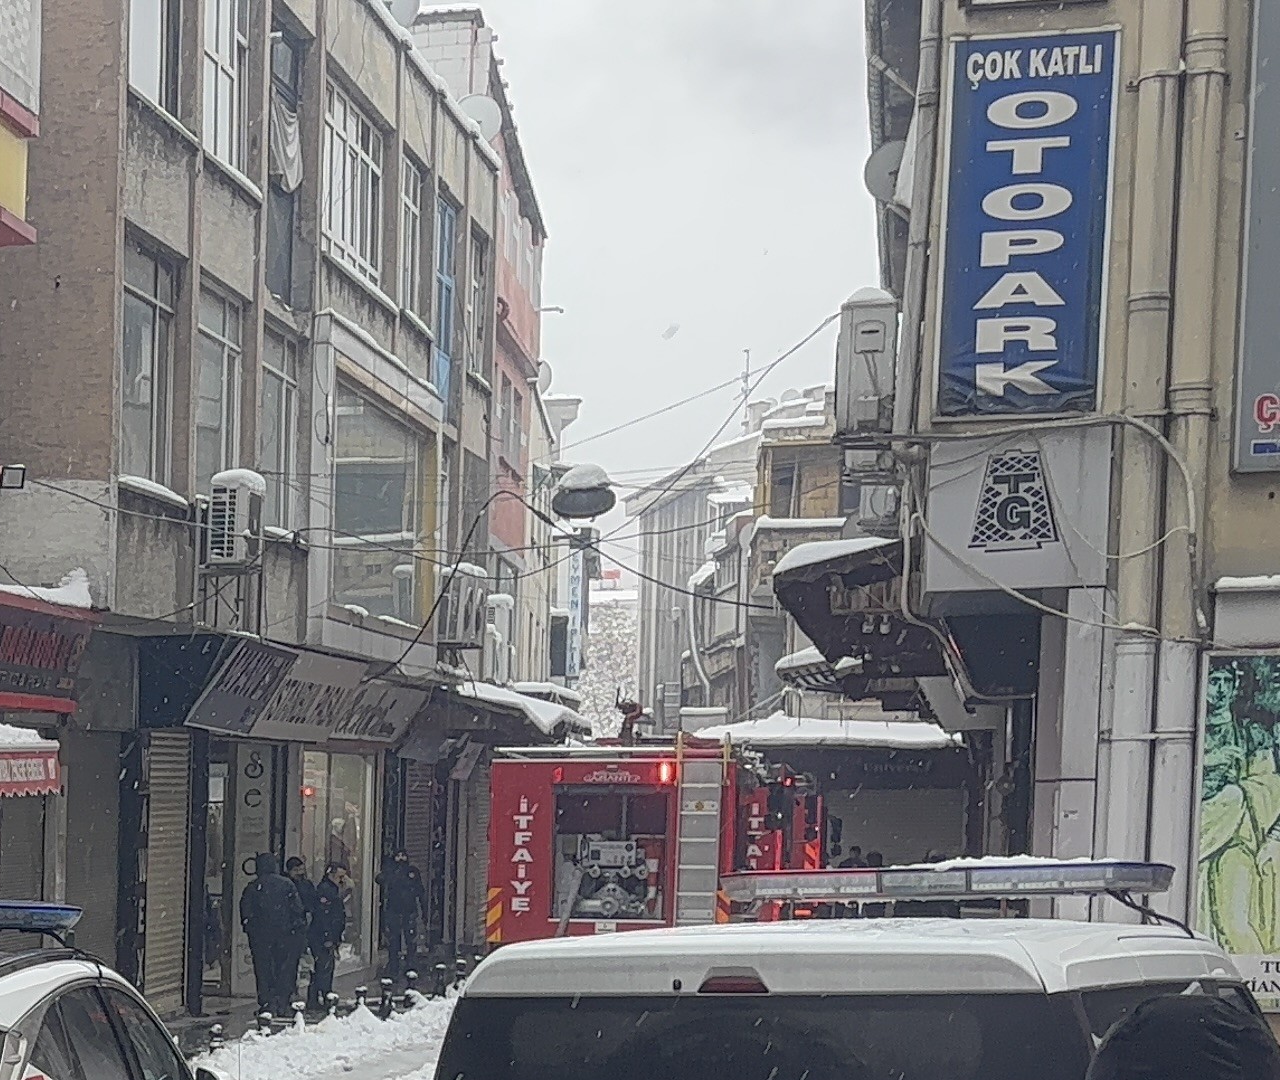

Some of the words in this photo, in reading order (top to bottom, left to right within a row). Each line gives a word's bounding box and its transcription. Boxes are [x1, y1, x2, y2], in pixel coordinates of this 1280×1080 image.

[966, 50, 1024, 90] ÇOK
[1029, 44, 1102, 78] KATLI
[972, 91, 1079, 397] OTOPARK
